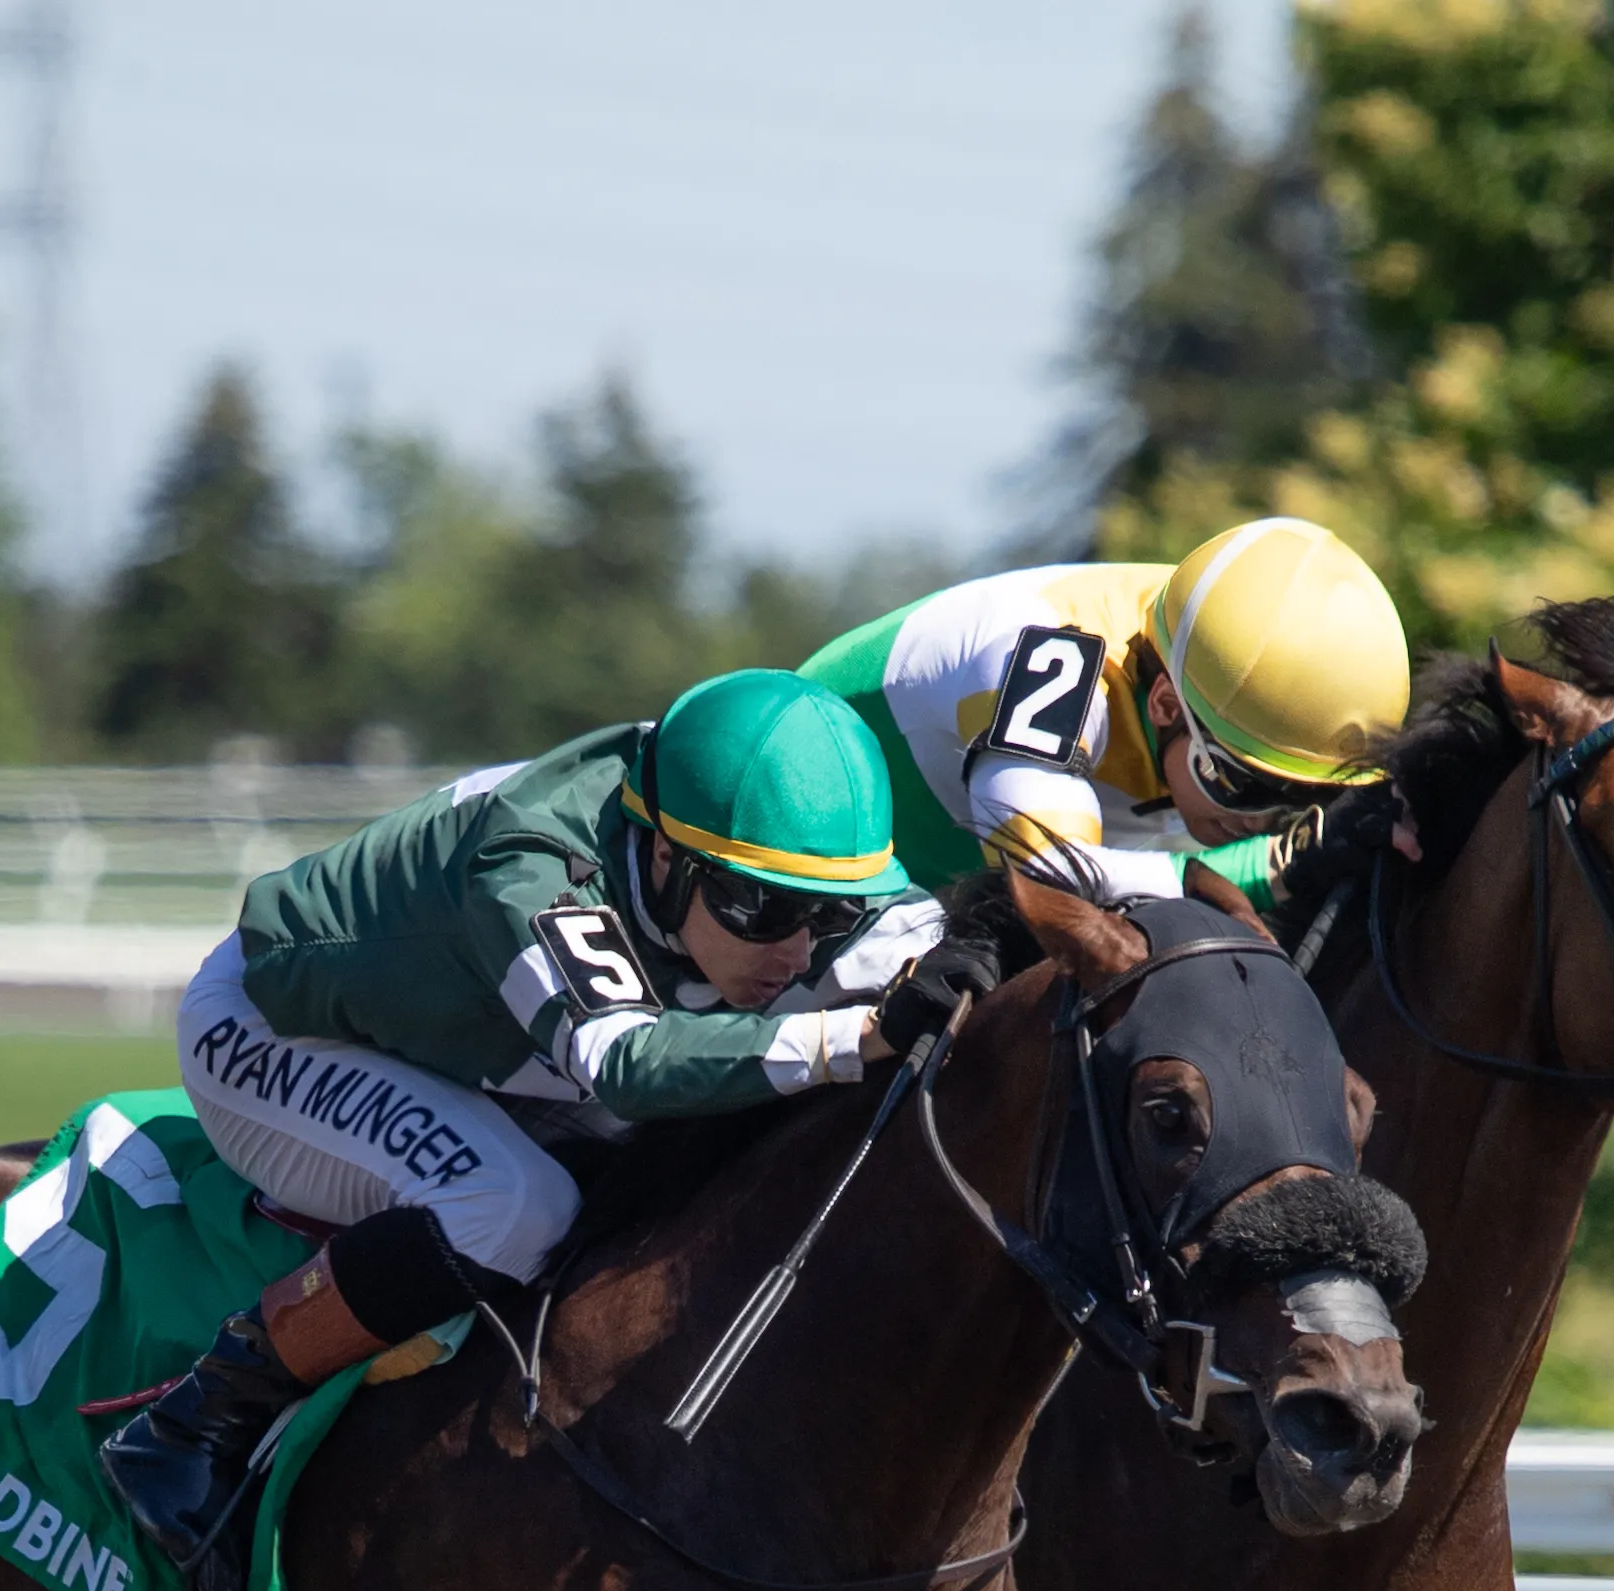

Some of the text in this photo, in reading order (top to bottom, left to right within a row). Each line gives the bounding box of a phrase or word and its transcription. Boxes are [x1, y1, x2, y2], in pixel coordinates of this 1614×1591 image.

[1004, 637, 1084, 755] 2
[555, 915, 645, 1002] 5
[194, 1016, 483, 1187] RYAN MUNGER
